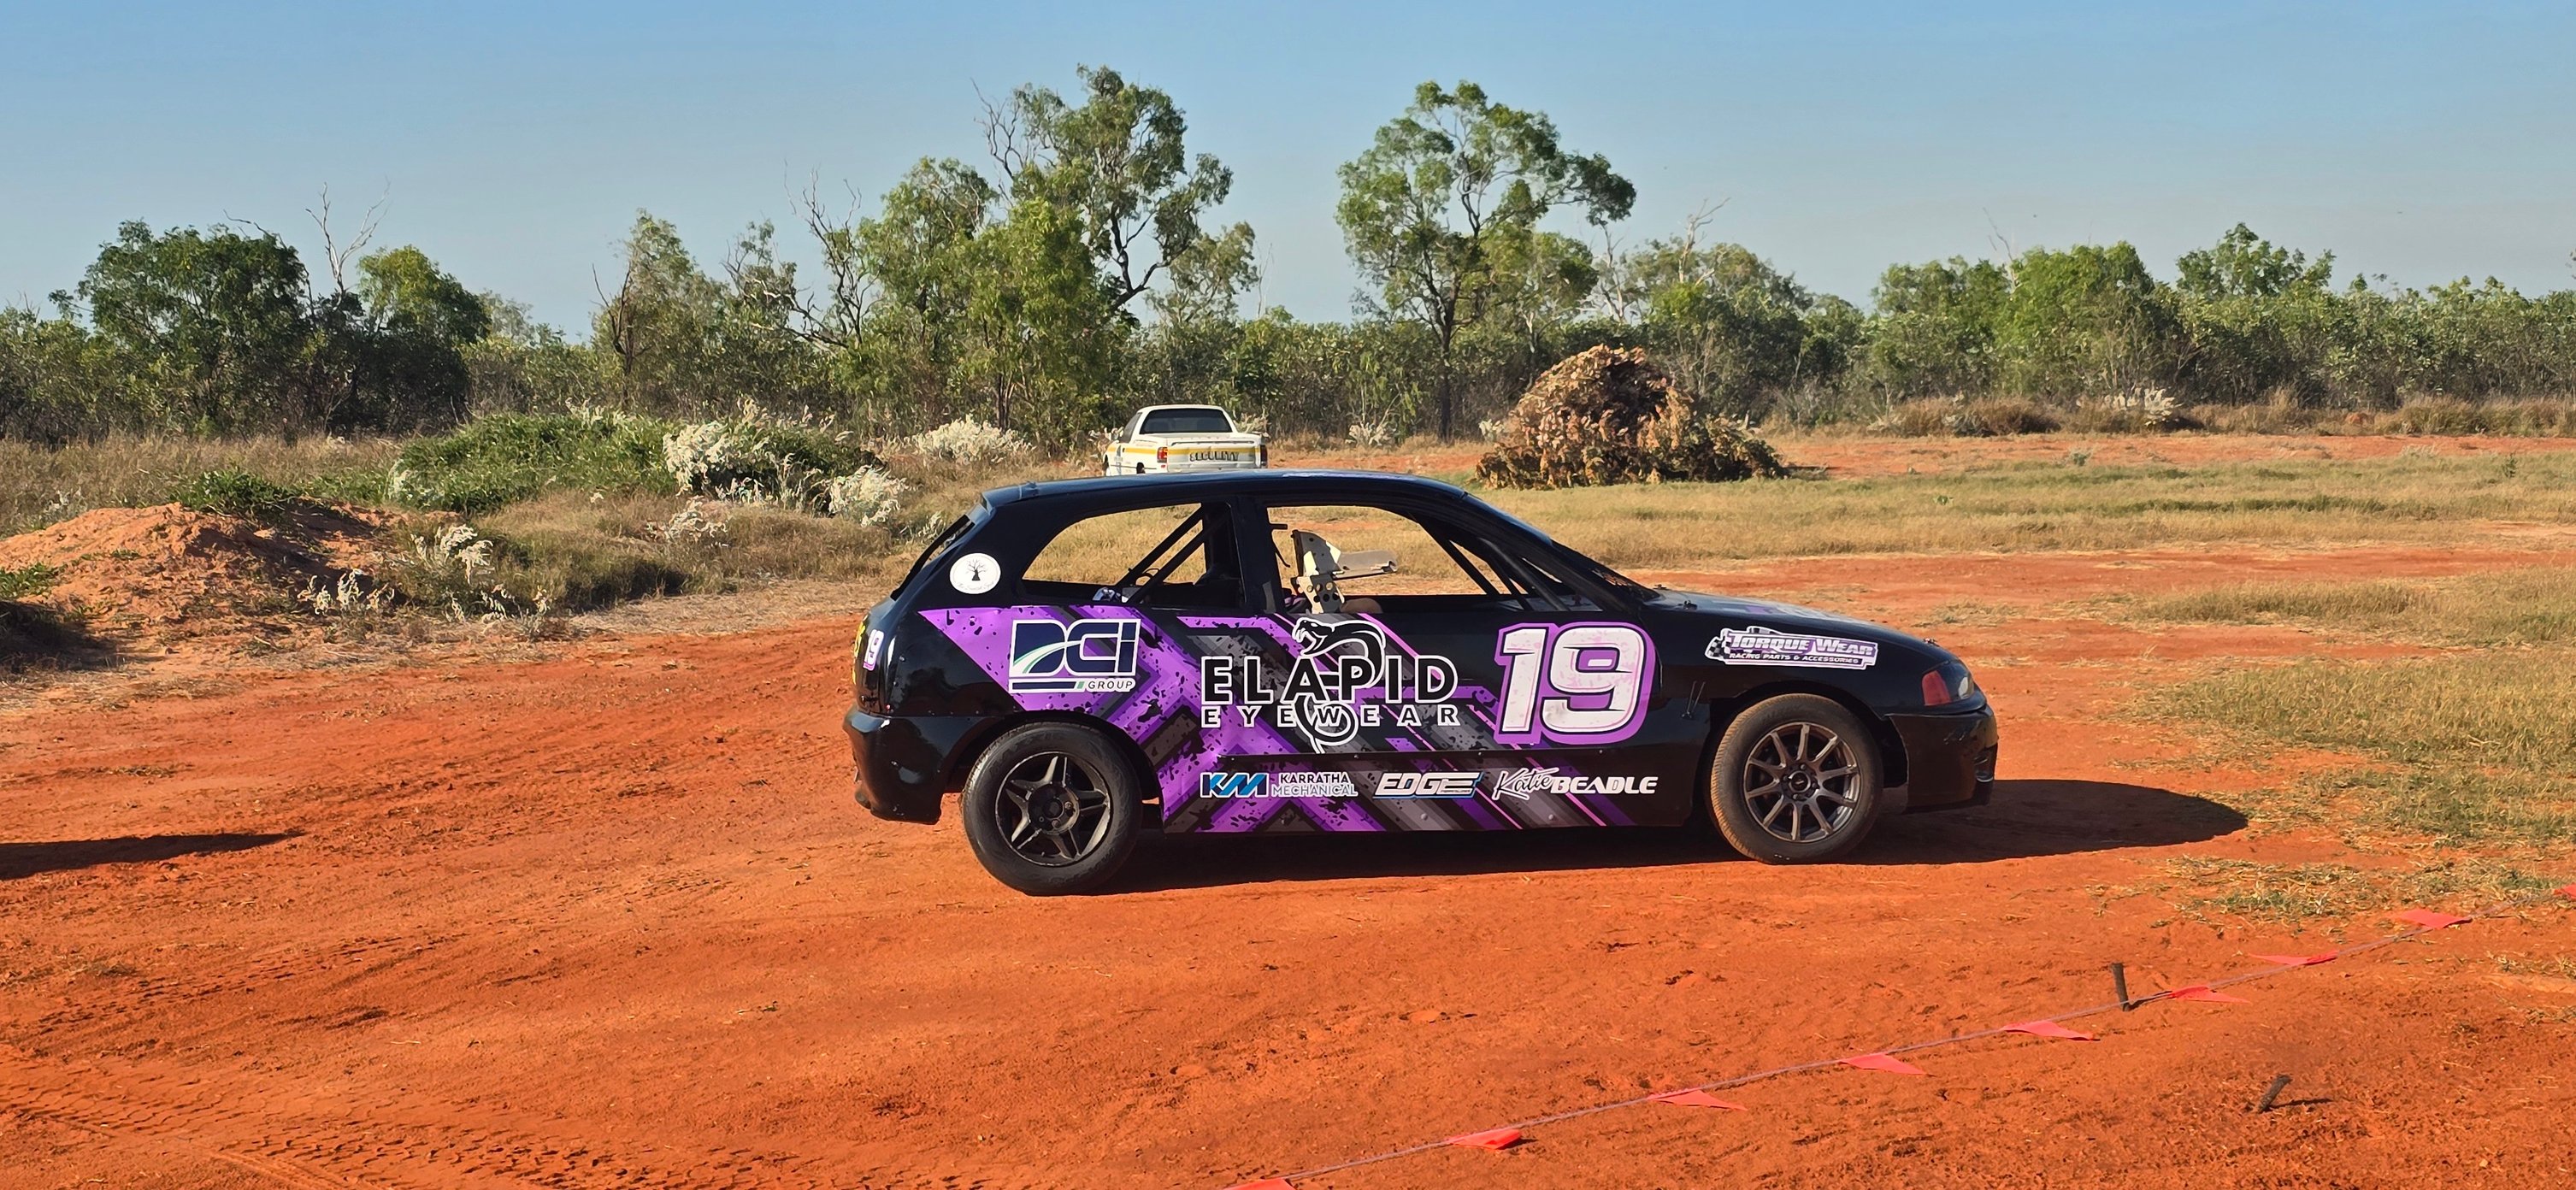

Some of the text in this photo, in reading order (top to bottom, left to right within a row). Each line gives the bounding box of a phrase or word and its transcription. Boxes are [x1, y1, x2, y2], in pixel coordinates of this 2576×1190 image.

[1801, 655, 1859, 663] ACCESSORIES
[1088, 680, 1133, 690] GROUP
[1201, 655, 1459, 704] ELAPID
[1498, 626, 1646, 735] 19
[1201, 704, 1460, 728] EYEWEAR
[1200, 773, 1268, 798] KM
[1280, 772, 1351, 784] KARRATHA
[1375, 772, 1480, 795] EDGE
[1492, 768, 1659, 800] Katie BEADLE
[1271, 783, 1358, 797] MECHANICAL
